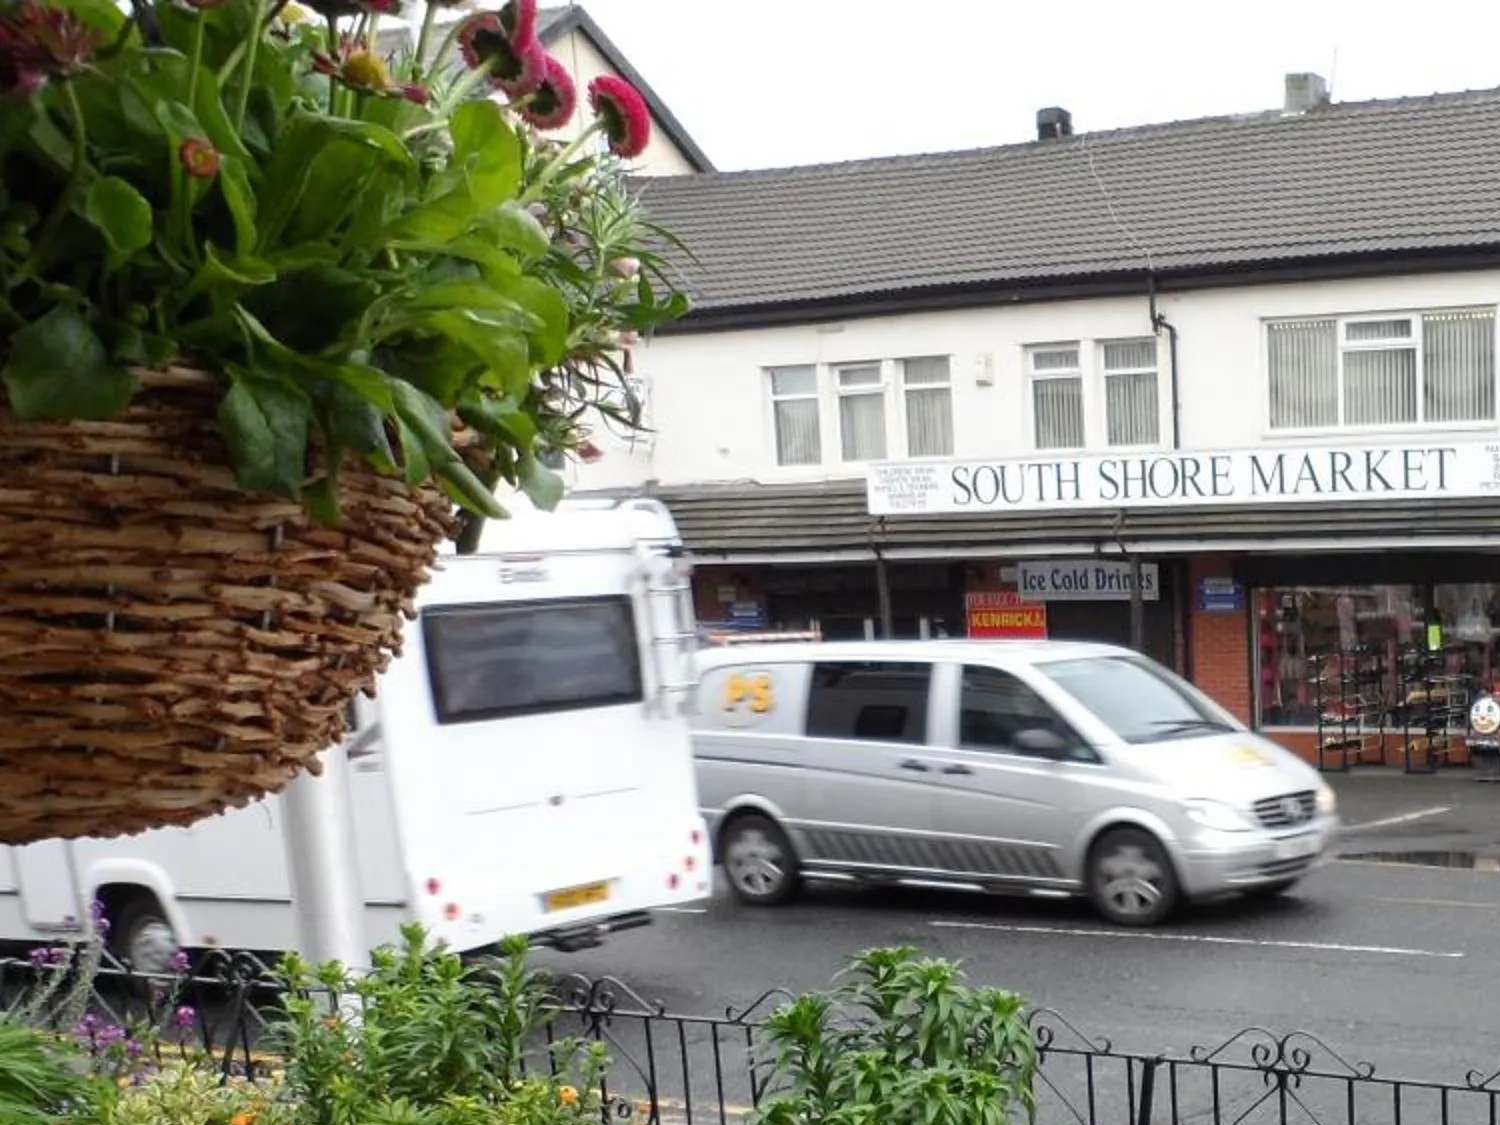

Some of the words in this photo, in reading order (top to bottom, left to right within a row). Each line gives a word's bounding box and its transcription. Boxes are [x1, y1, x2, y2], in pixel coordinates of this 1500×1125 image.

[951, 461, 1082, 505] SOUTH
[1099, 455, 1235, 499] SHORE
[1248, 447, 1457, 496] MARKET
[1022, 569, 1047, 591] Ice
[1050, 567, 1089, 591] Cold
